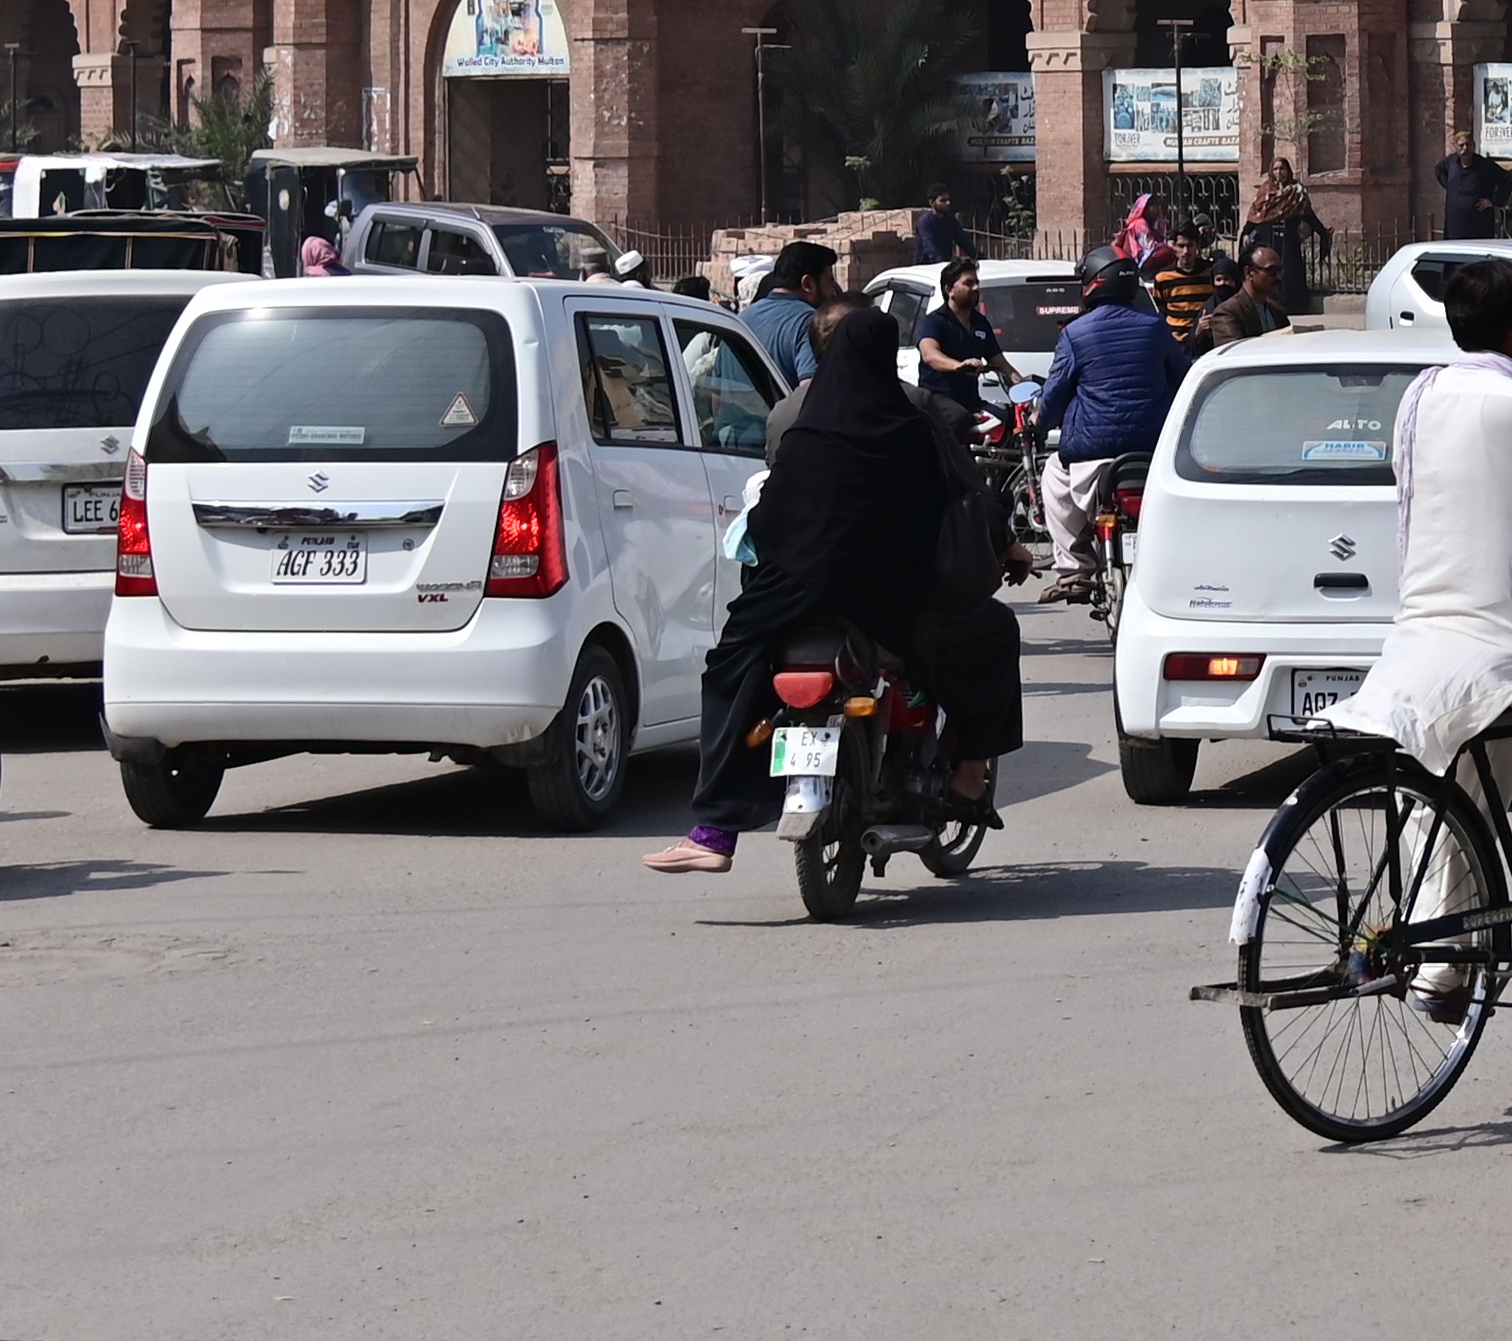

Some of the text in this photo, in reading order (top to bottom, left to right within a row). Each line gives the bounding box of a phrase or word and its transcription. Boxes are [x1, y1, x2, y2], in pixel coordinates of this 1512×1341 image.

[457, 56, 564, 68] Walled City Authority Multan
[1166, 138, 1193, 146] MULAN
[1194, 137, 1219, 145] CRAFTS
[1039, 306, 1080, 314] SUPREME
[1326, 419, 1381, 430] ALTO
[73, 500, 119, 522] LEE 6
[301, 537, 335, 546] PUNJAB
[277, 549, 360, 576] AGF 333
[418, 593, 448, 603] VXL
[1326, 674, 1360, 682] PUNJAB
